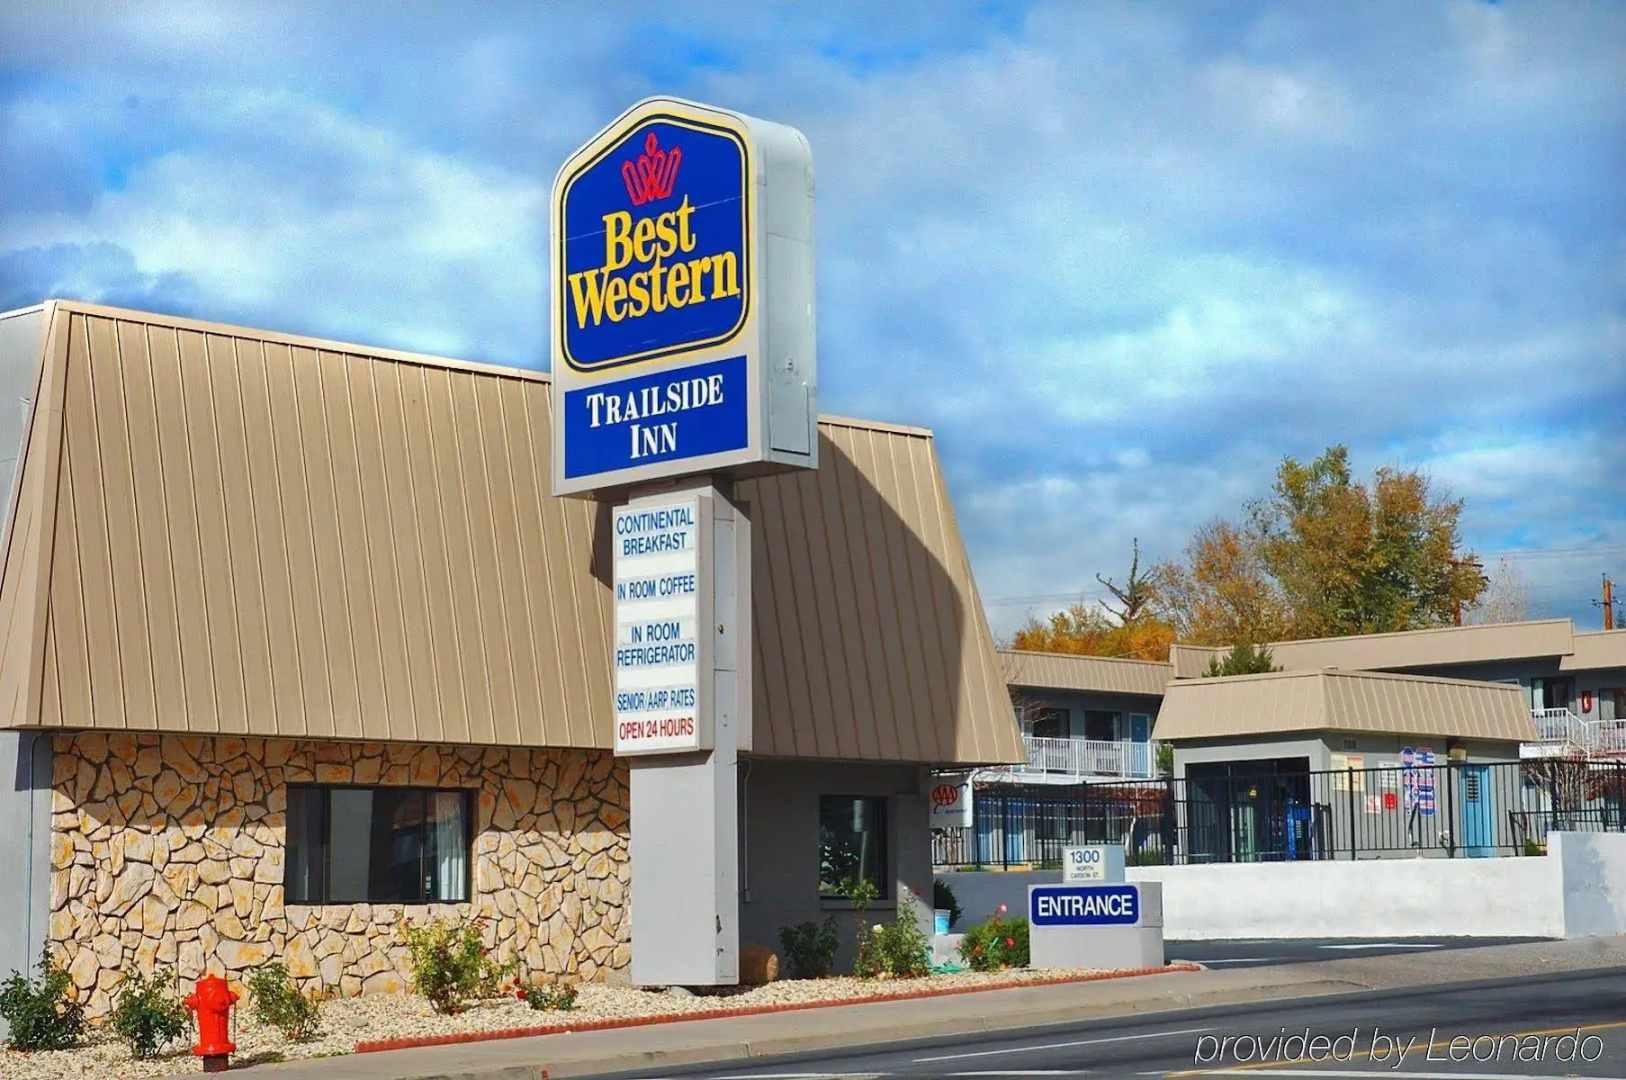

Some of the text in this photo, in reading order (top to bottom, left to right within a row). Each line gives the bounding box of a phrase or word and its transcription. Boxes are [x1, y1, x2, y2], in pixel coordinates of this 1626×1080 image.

[602, 194, 696, 271] Best
[568, 251, 740, 329] Western
[586, 374, 724, 428] TRAILSIDE
[630, 423, 677, 459] INN
[616, 508, 694, 534] CONTINENTAL
[623, 532, 687, 556] BREAKFAST
[617, 575, 695, 601] IN ROOM COFFEE
[631, 622, 680, 643] IN ROOM
[617, 643, 695, 667] REFRIGERATOR
[670, 688, 695, 707] RATES
[619, 717, 694, 740] OPEN 24 HOURS
[1070, 850, 1100, 864] 1300
[1038, 895, 1133, 917] ENTRANCE
